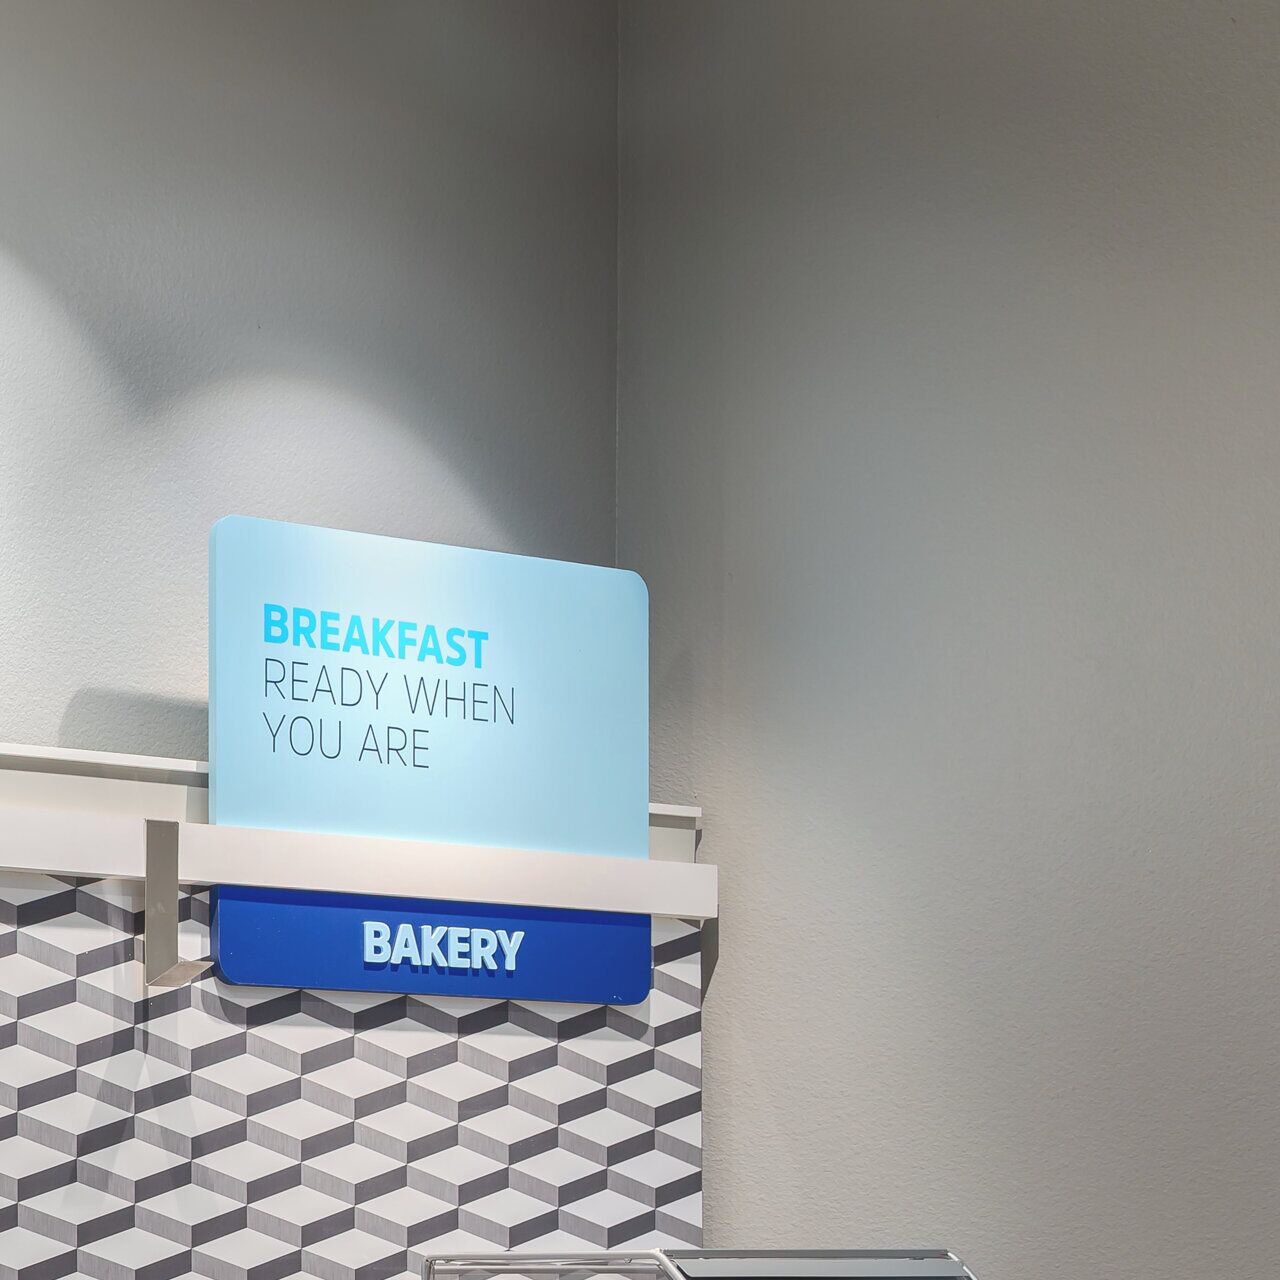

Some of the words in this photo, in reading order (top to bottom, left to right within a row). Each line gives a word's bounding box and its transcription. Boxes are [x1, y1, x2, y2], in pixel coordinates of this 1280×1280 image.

[263, 603, 489, 669] BREAKFAST
[263, 658, 389, 710] READY
[403, 674, 516, 725] WHEN
[262, 711, 342, 759] YOU
[358, 723, 429, 769] ARE
[362, 920, 525, 971] BAKERY
